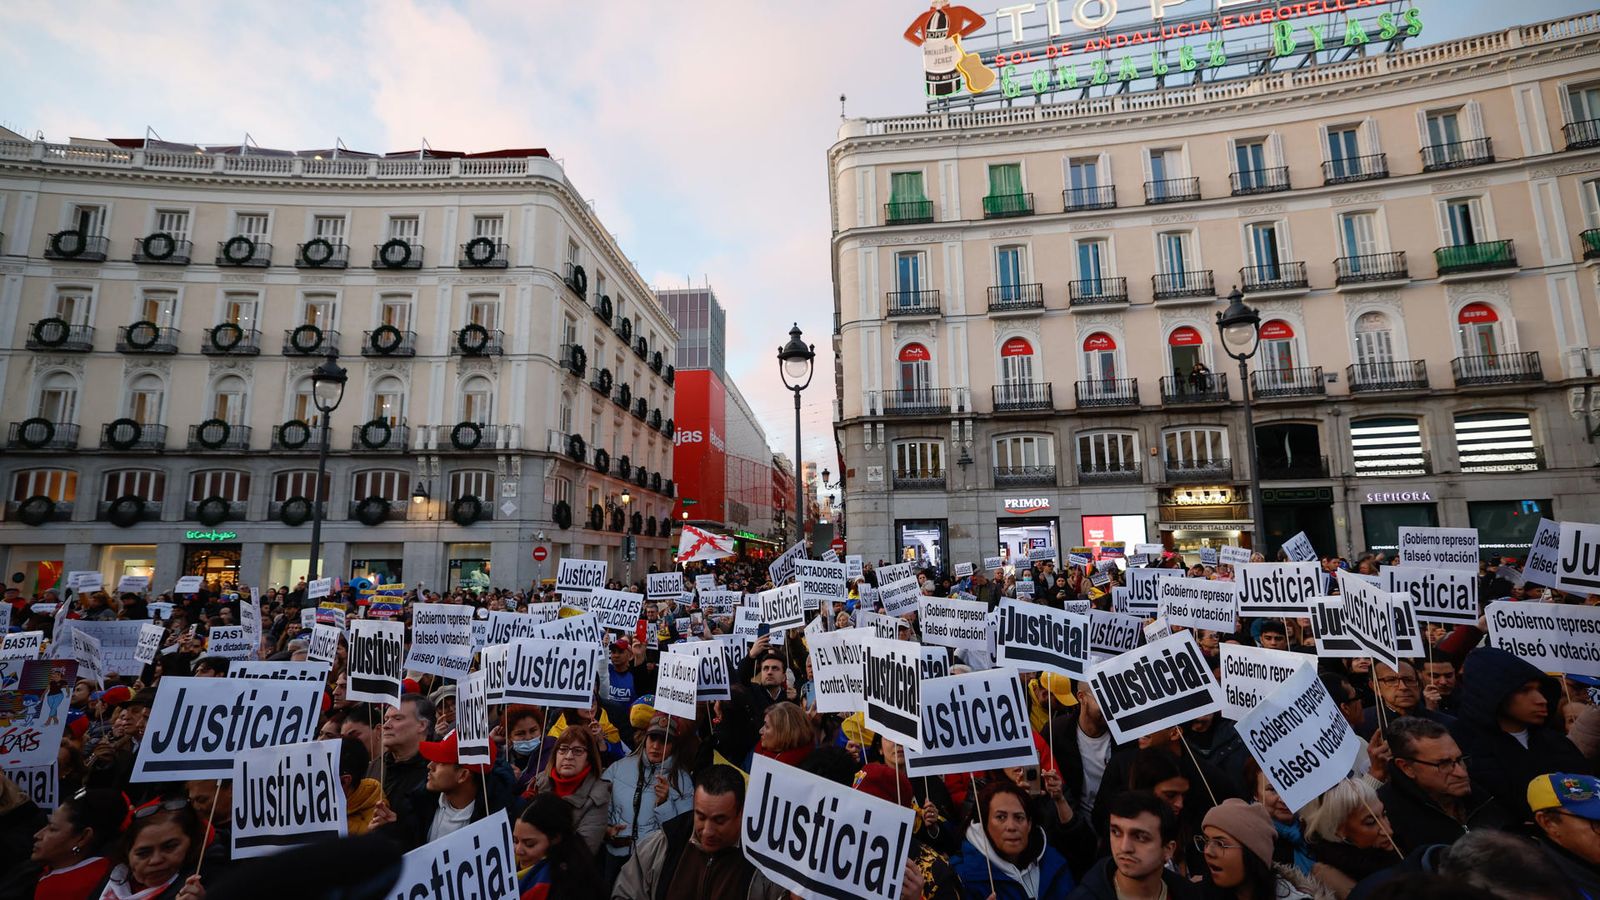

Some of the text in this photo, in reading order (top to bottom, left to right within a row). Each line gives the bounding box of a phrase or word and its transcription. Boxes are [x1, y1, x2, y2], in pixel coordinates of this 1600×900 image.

[994, 51, 1039, 68] SOL
[1046, 40, 1074, 59] DE
[1084, 20, 1213, 53] ANDALUCIA
[1222, 0, 1392, 30] EMBOTELL
[996, 0, 1118, 43] TIO
[1001, 8, 1424, 98] GONZALEZ BYASS
[1004, 498, 1050, 508] PRIMOR
[1367, 491, 1431, 502] SEPHORA
[1402, 532, 1476, 549] ¡Gobierno represor
[1403, 551, 1477, 564] falseó votación!
[558, 562, 606, 587] Justicia!
[648, 575, 682, 593] Justicia!
[796, 565, 845, 580] DICTADORES,
[1239, 567, 1322, 603] Justicia!
[591, 596, 641, 614] CALLAR ES
[700, 595, 724, 604] CALLAR
[725, 595, 733, 603] ES
[761, 586, 803, 624] Justicia!
[1162, 583, 1234, 604] ¡Gobierno represor
[415, 610, 471, 628] ¡Gobierno represor
[925, 603, 986, 623] ¡Gobierno represor
[1166, 602, 1233, 622] alseó votación!
[1341, 577, 1396, 651] Justicia!
[1492, 610, 1553, 633] ¡Gobierno
[415, 631, 471, 647] falseó votación!
[925, 621, 986, 640] falseó votación!
[999, 606, 1089, 660] ¡Justicia!
[3, 637, 38, 650] BASTA
[348, 628, 403, 680] ¡Justicia!
[1498, 637, 1600, 662] falseó votació
[507, 644, 596, 691] Justicia!
[815, 648, 832, 671] ¡EL
[1224, 654, 1267, 680] ¡Gobierno
[609, 686, 631, 697] NASA
[820, 676, 845, 694] contra
[862, 646, 920, 718] ¡Justicia!
[1092, 642, 1211, 721] ¡Justicia!
[1226, 683, 1257, 708] falseó
[151, 687, 320, 754] Justicia!
[920, 677, 1029, 749] usticia!
[1250, 677, 1327, 763] ¡Gobierno represor
[1270, 743, 1320, 791] falseó
[235, 752, 338, 830] Justicia!
[746, 772, 908, 899] Justicia!
